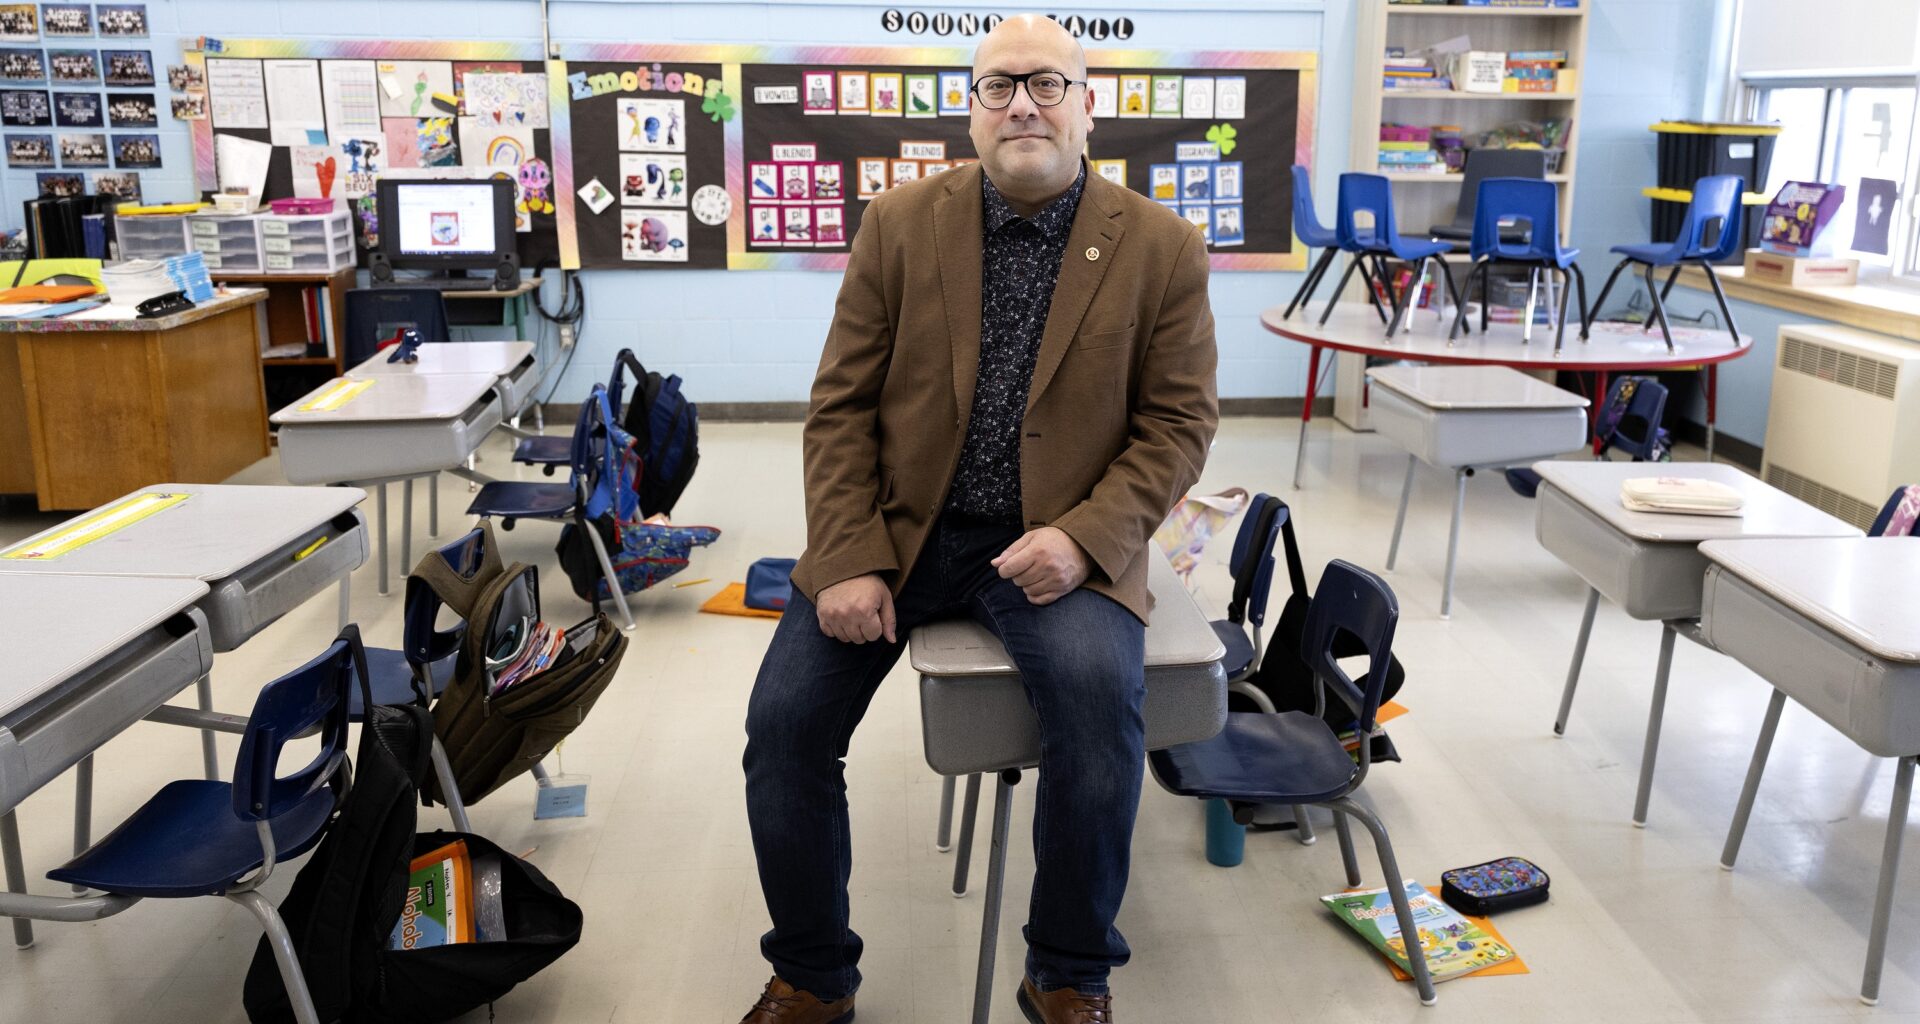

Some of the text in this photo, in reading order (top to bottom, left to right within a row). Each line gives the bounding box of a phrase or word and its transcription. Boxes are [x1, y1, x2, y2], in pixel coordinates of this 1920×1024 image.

[1055, 14, 1129, 40] ALL
[782, 148, 812, 158] BLENDS
[912, 146, 942, 156] BLENDS
[759, 165, 769, 176] bl
[790, 165, 800, 176] cl
[865, 162, 880, 172] br
[898, 164, 912, 172] cr
[1157, 168, 1172, 178] ch
[1190, 168, 1204, 177] sh
[1220, 167, 1235, 178] ph
[760, 208, 769, 220] gl
[792, 208, 802, 219] pl
[824, 208, 833, 218] sl
[401, 886, 422, 950] Alphab
